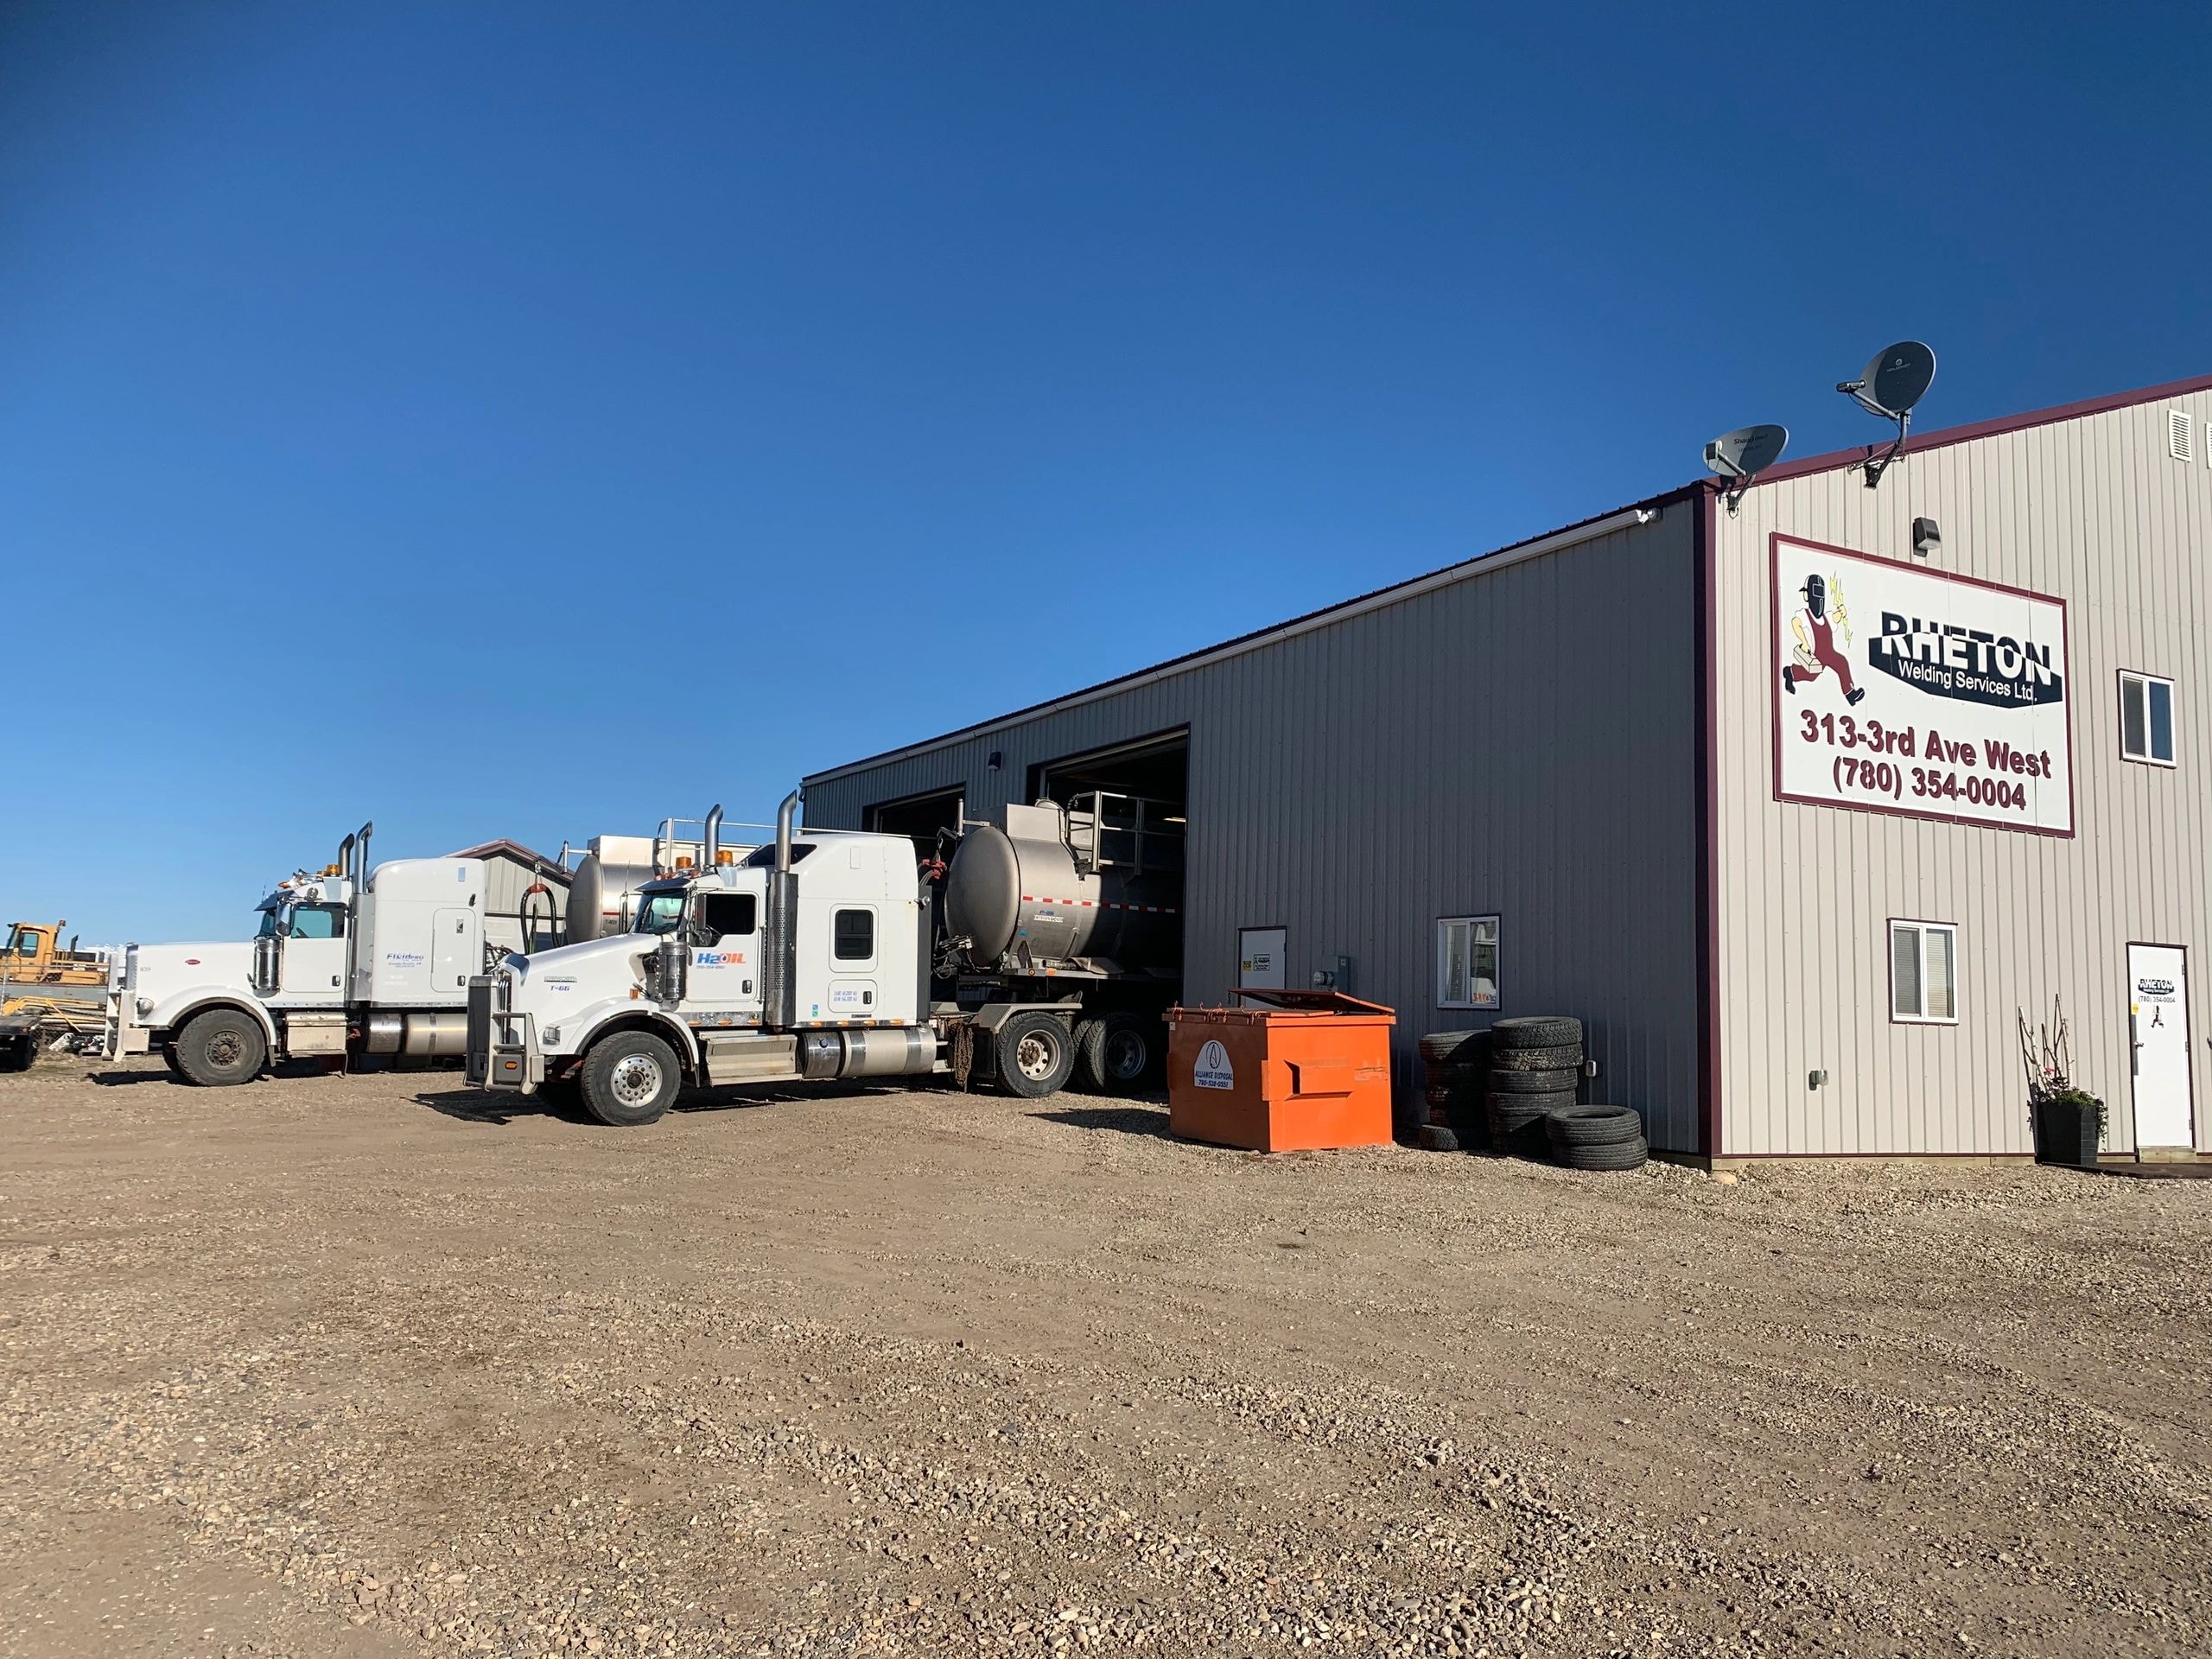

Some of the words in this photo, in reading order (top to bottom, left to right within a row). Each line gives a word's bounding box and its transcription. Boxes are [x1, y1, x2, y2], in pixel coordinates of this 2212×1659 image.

[1881, 611, 2051, 686] RHETON
[1897, 658, 1952, 689] Welding
[1955, 671, 2012, 696] Services
[2013, 681, 2038, 702] Ltd.
[1800, 709, 1916, 759] 313-3rd
[1924, 729, 1977, 767] Ave
[1984, 739, 2052, 779] West
[1833, 755, 1903, 801] (780)
[1910, 766, 2027, 810] 354-0004
[696, 952, 747, 964] H2OIL
[2139, 978, 2173, 989] RHETON
